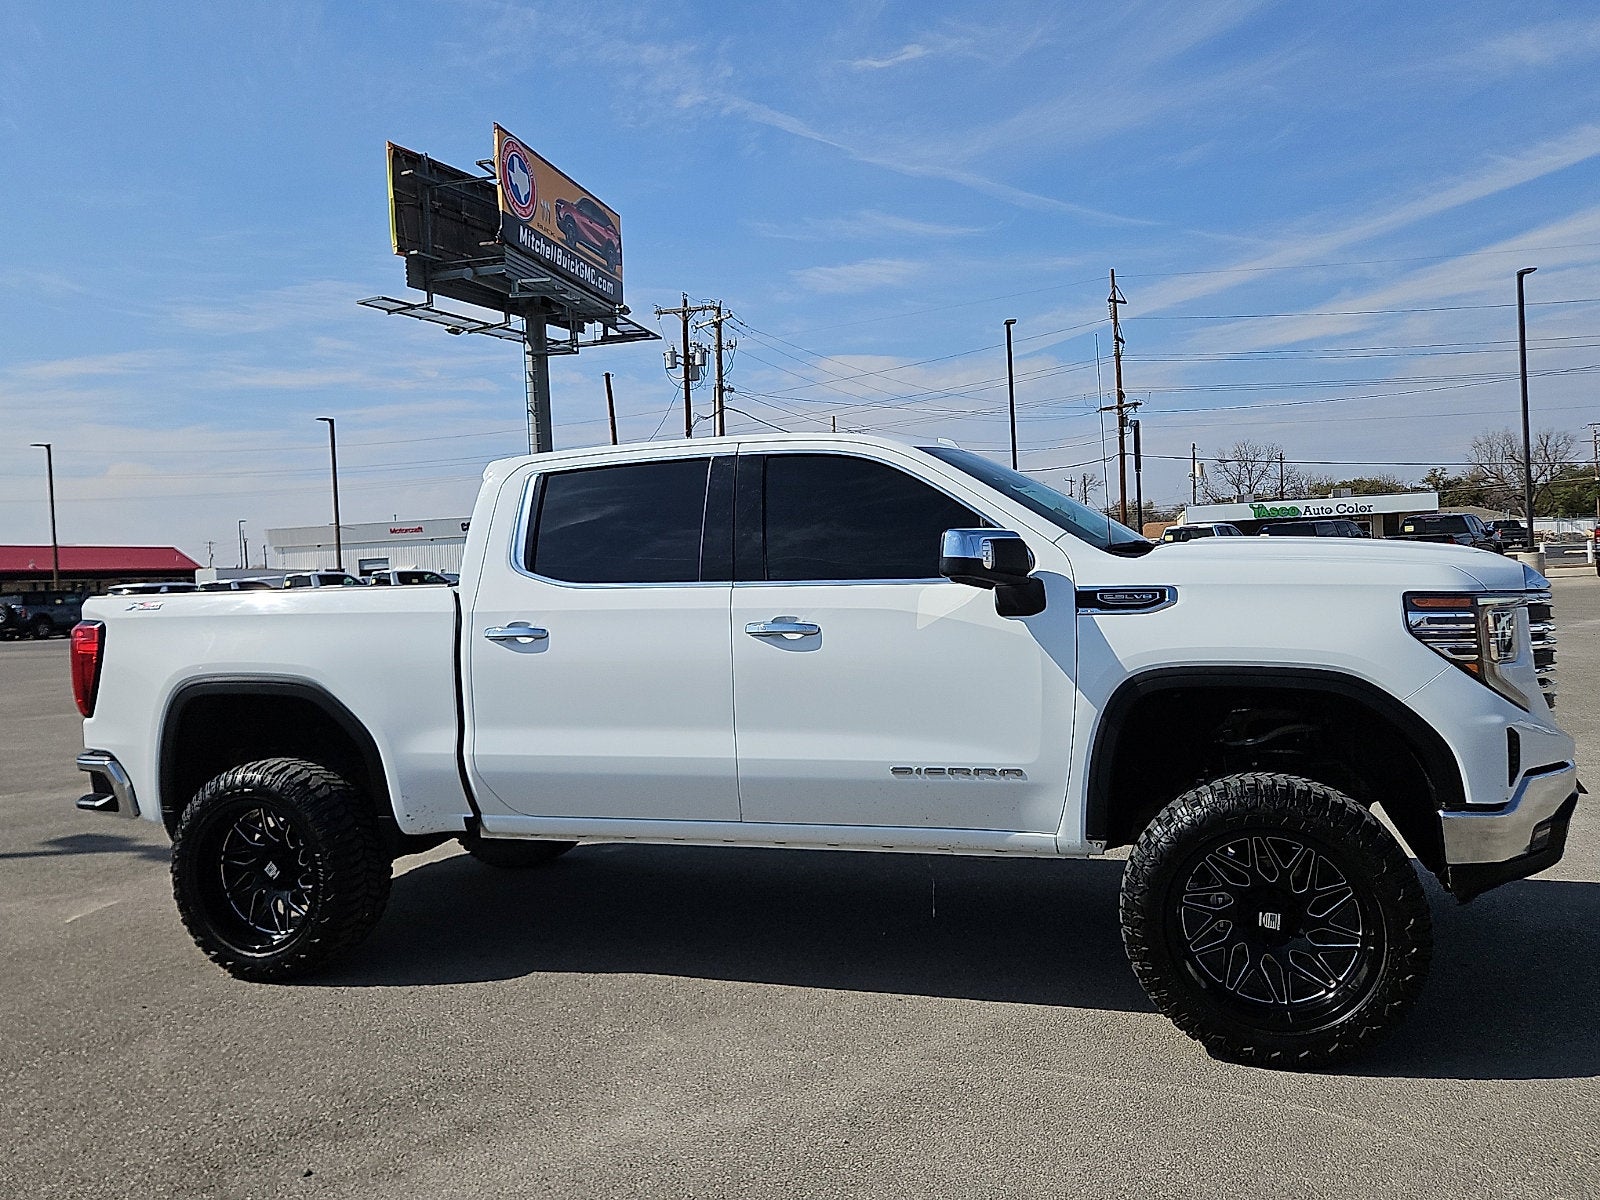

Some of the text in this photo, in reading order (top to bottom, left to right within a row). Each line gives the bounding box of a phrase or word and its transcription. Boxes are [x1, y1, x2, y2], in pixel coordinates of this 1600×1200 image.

[519, 225, 615, 295] MitchellBuickGMC.com
[1302, 505, 1333, 516] Auto
[1335, 502, 1374, 514] Color
[389, 526, 424, 534] Motorcraft
[890, 766, 1024, 777] SIERRA
